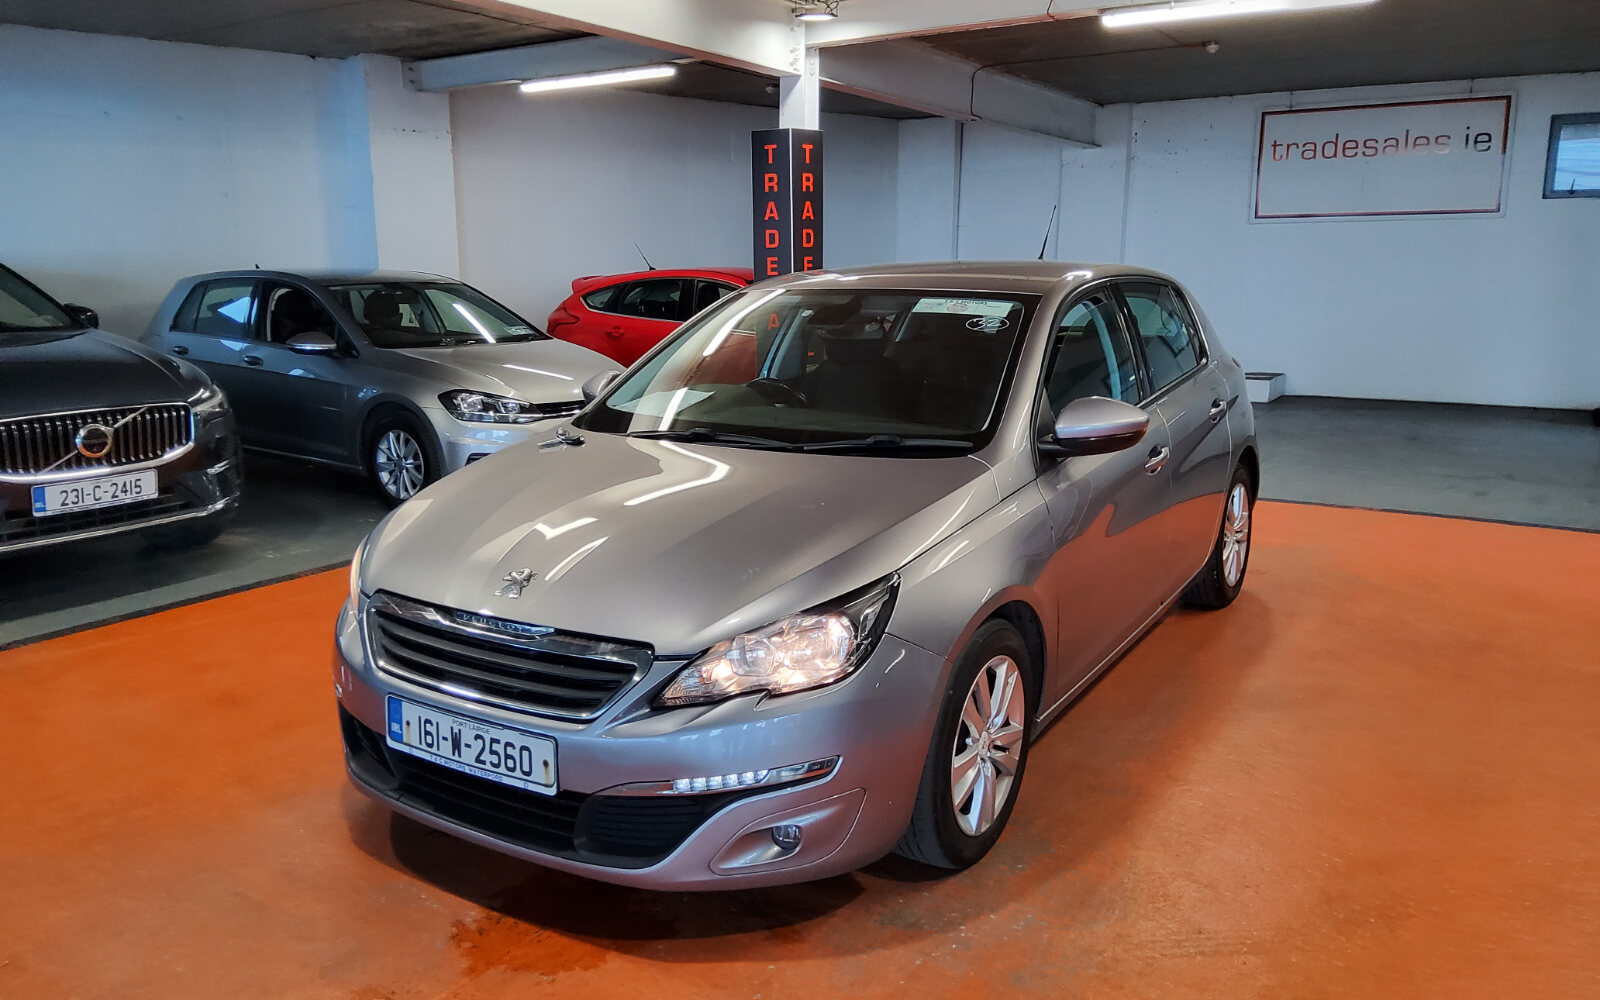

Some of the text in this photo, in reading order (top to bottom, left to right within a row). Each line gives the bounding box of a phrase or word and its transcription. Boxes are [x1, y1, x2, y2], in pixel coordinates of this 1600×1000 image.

[763, 143, 780, 276] TRADE
[59, 478, 143, 508] 231-C-2415
[418, 715, 533, 778] 161-W-2560
[467, 767, 504, 782] WATERFORD
